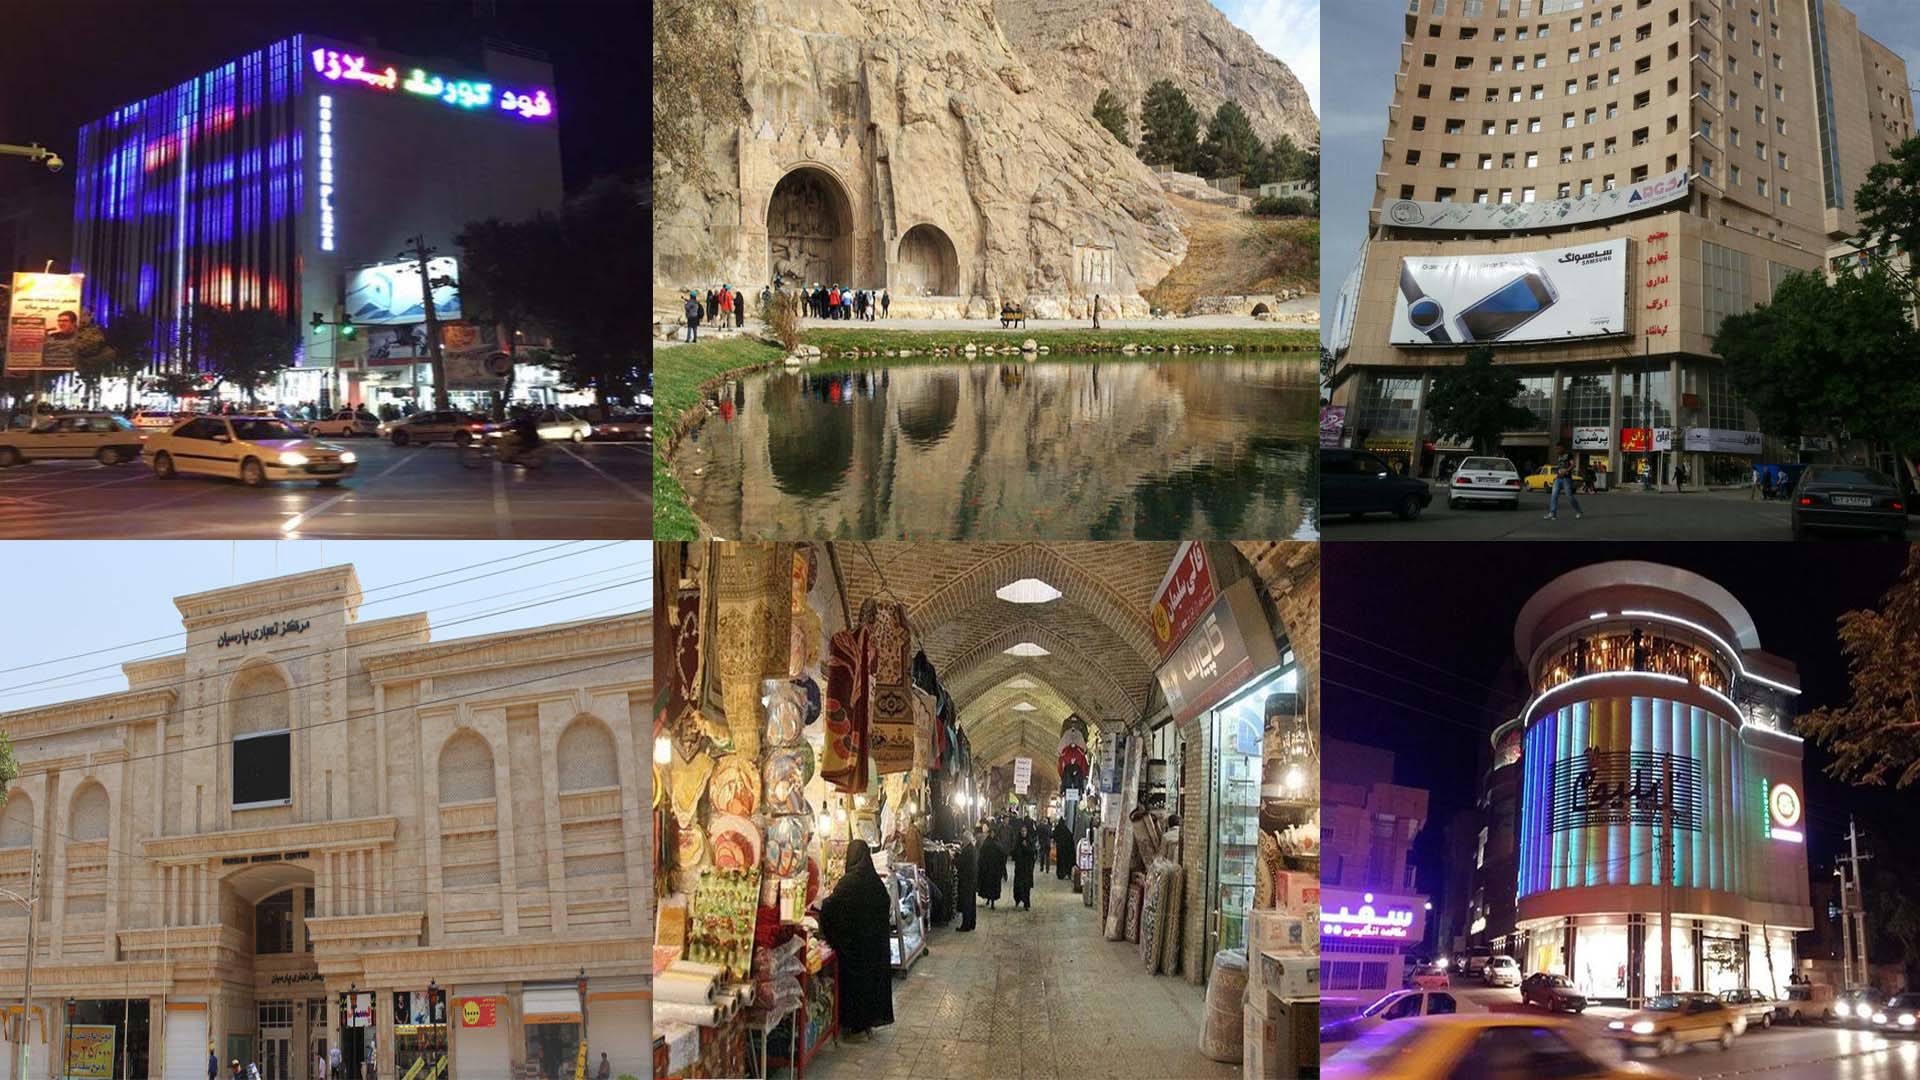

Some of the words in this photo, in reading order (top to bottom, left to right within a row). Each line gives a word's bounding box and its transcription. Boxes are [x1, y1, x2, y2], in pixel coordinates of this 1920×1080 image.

[404, 69, 492, 108] کورت
[501, 91, 551, 117] فود
[1558, 249, 1612, 265] سامسونگ
[1582, 256, 1612, 265] SAMSUNG
[1574, 431, 1608, 444] پرشین
[250, 622, 279, 641] تجاری
[279, 619, 310, 637] مرکز
[217, 628, 250, 648] پارسیان
